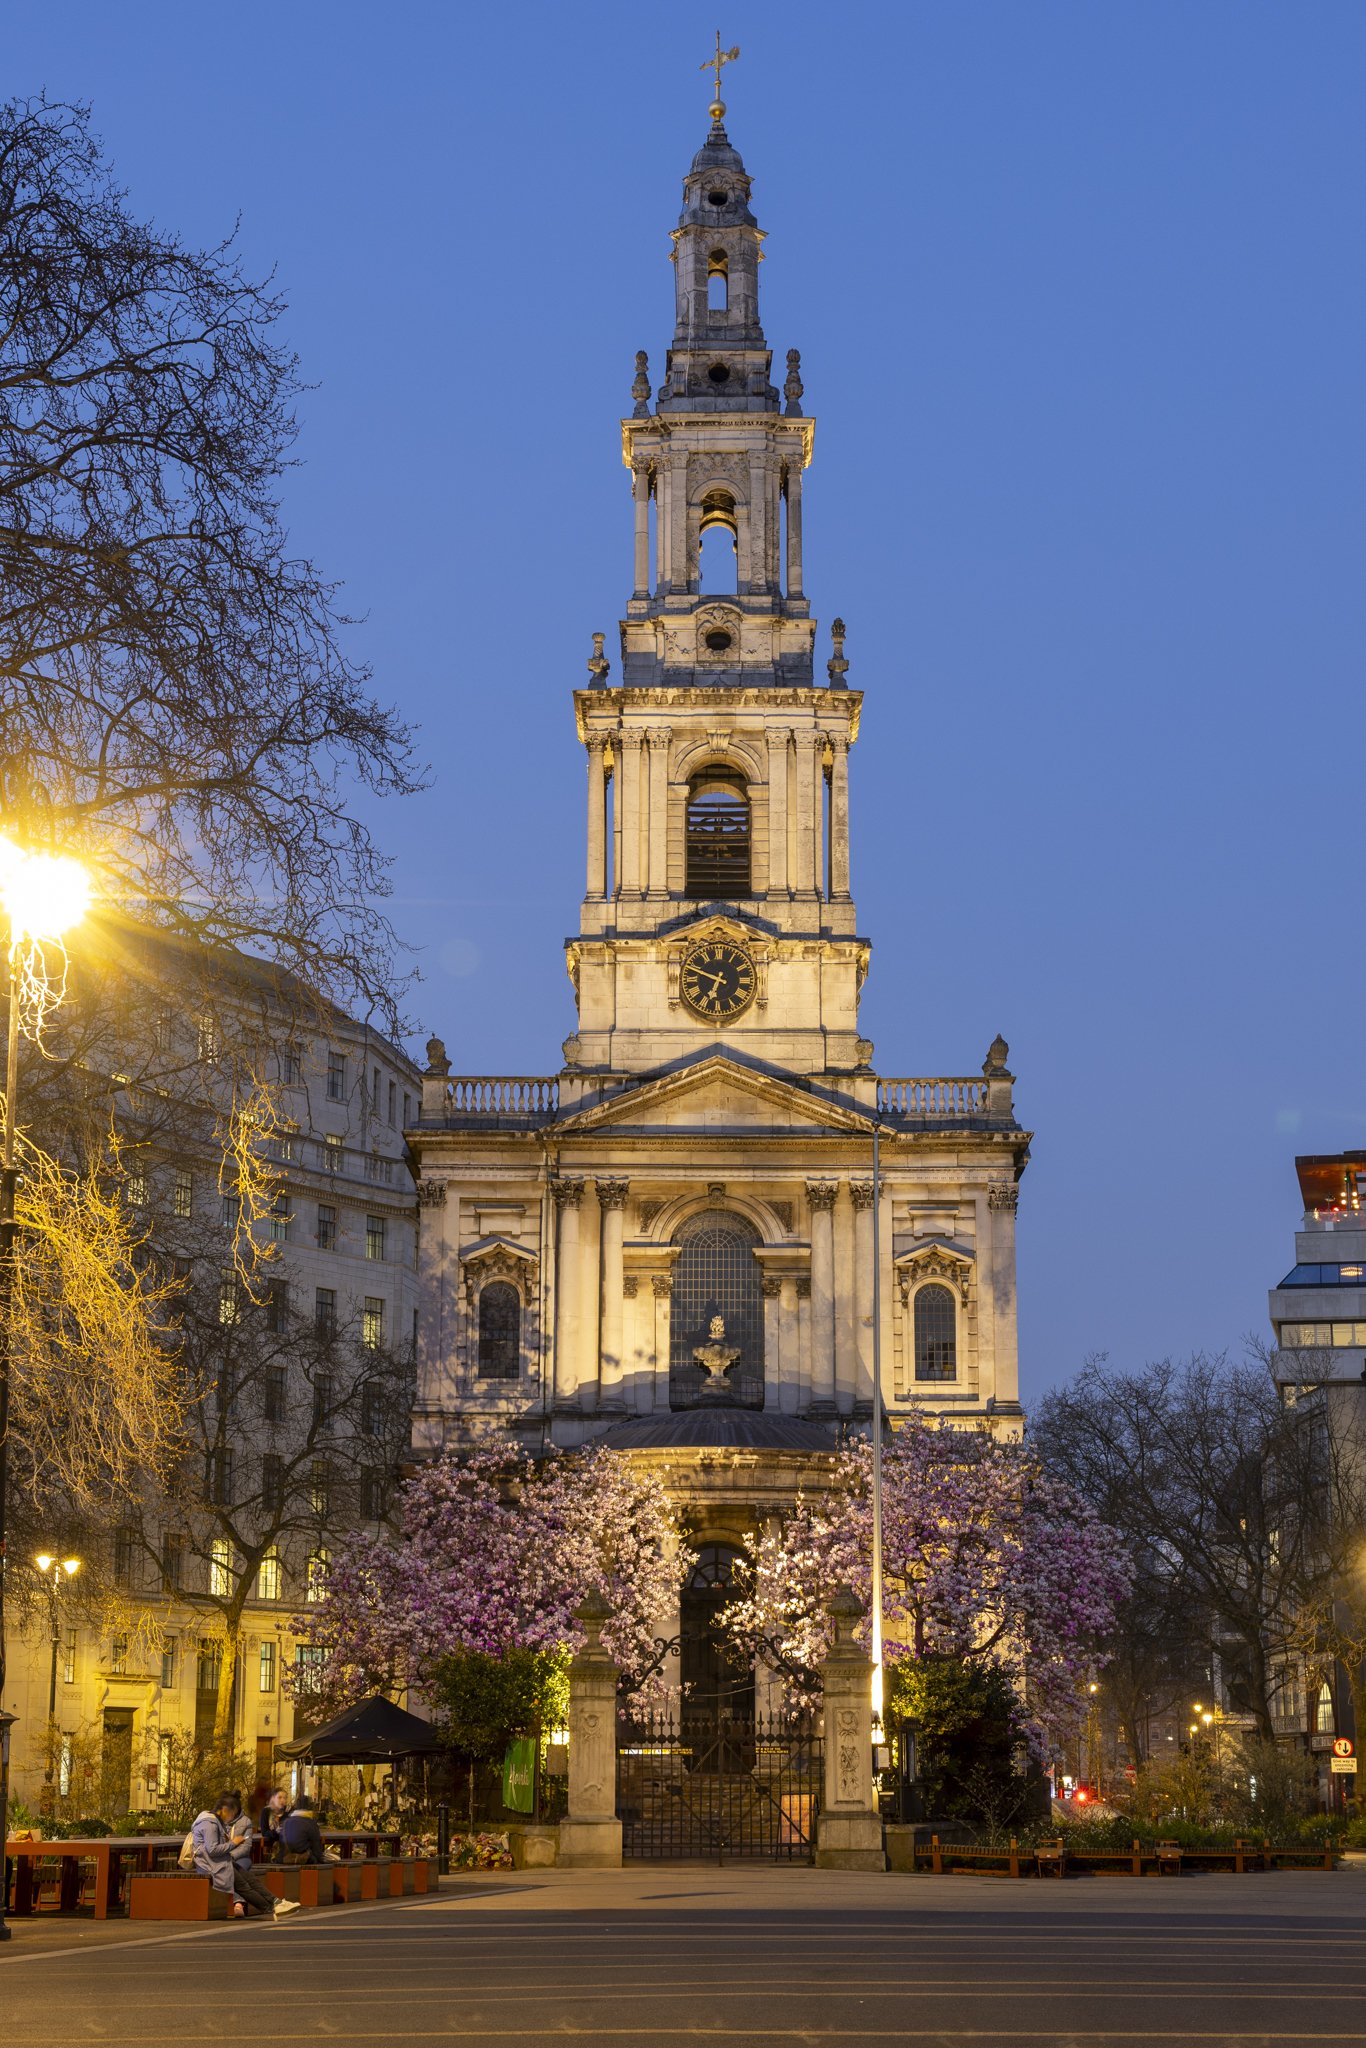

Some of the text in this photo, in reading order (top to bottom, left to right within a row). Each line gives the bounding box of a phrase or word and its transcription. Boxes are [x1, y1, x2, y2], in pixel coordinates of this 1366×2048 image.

[700, 951, 710, 964] XI
[715, 949, 723, 960] XII
[728, 953, 736, 963] I
[736, 963, 748, 972] II
[688, 986, 700, 998] VIII
[699, 995, 709, 1008] VII
[715, 1000, 720, 1010] VI
[728, 998, 736, 1008] V
